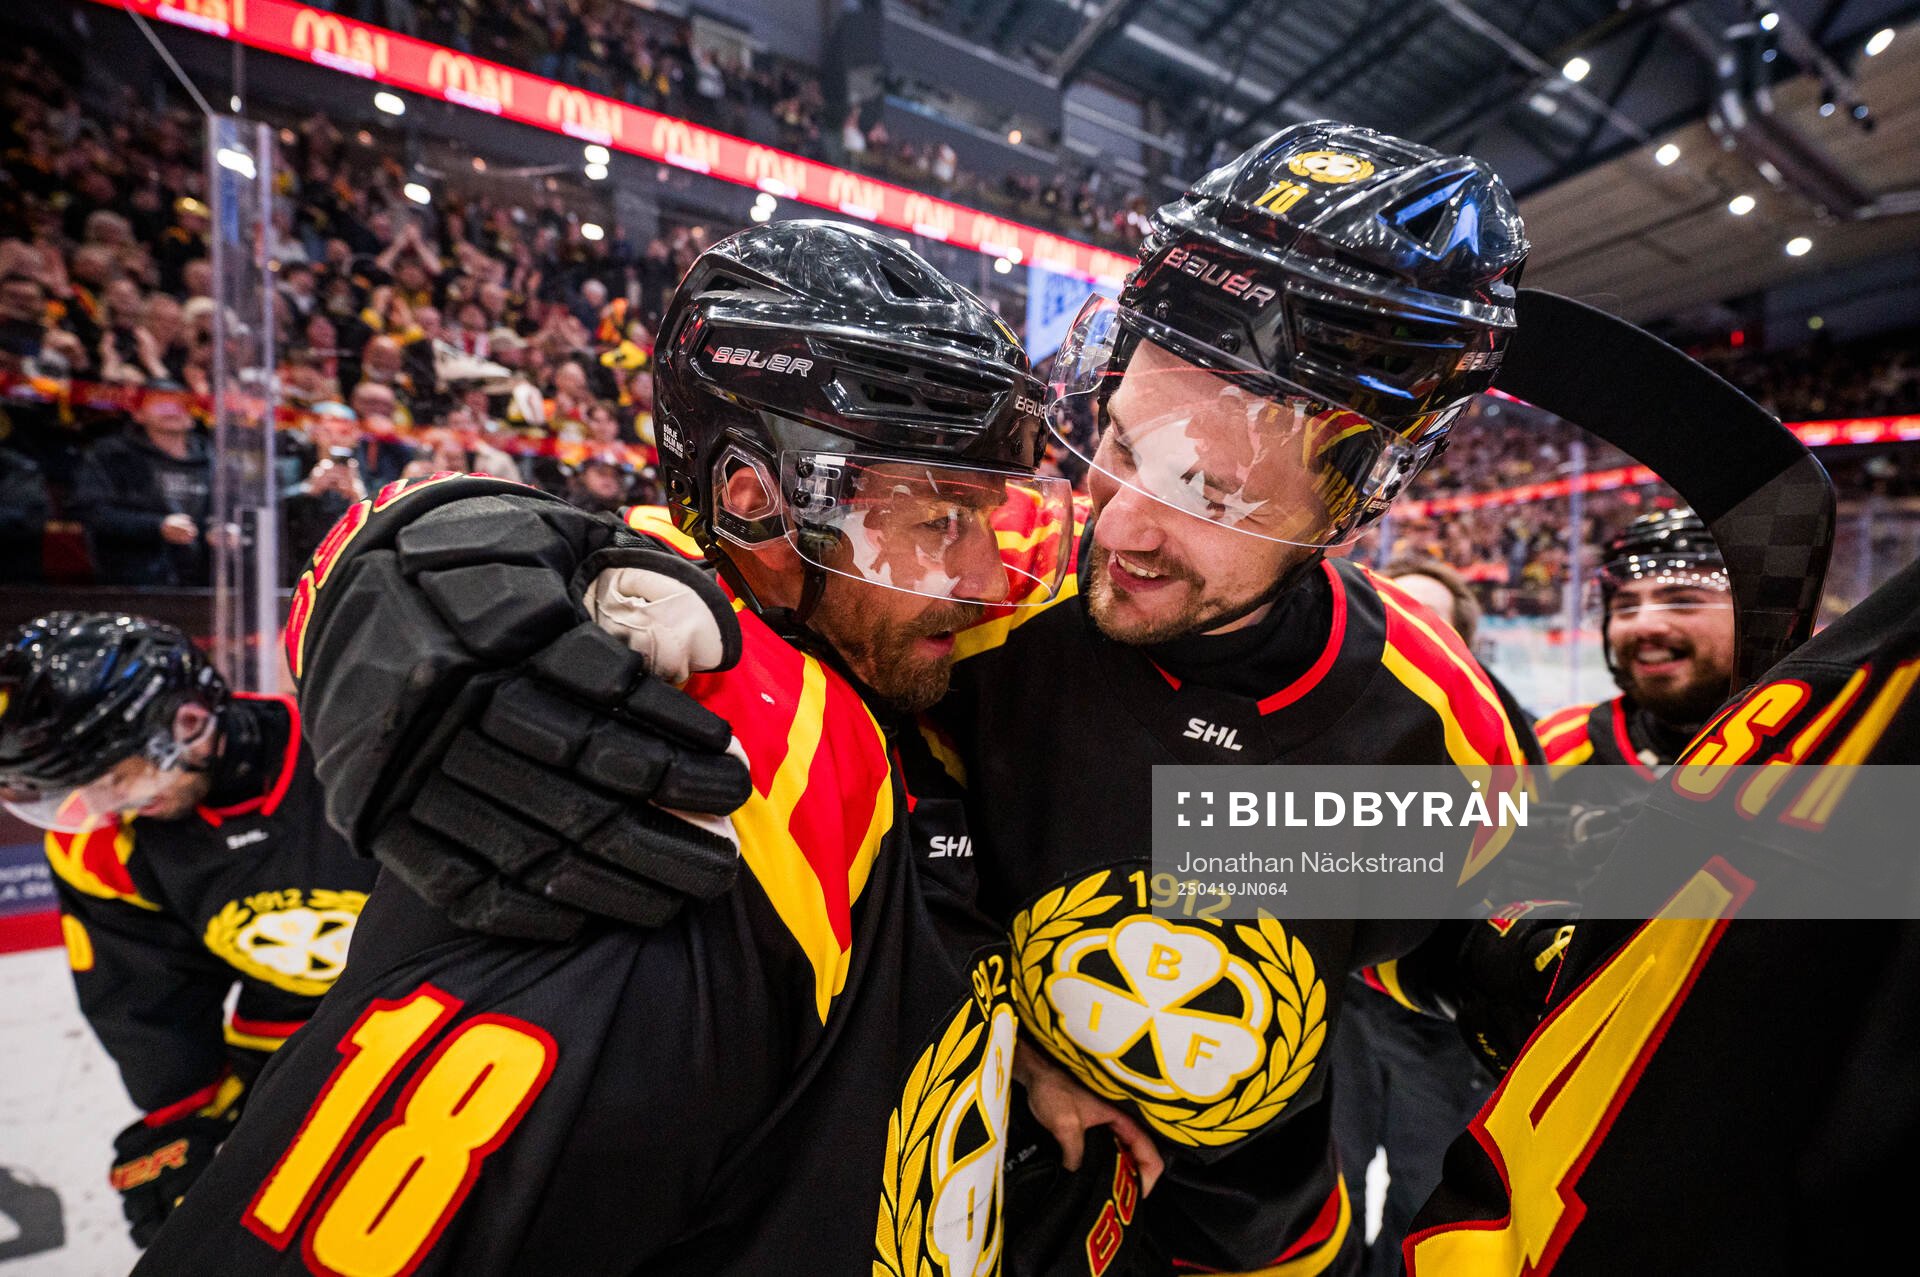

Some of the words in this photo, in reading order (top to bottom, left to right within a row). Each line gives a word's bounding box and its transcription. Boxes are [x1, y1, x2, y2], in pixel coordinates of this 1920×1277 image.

[1163, 247, 1277, 308] BAUER
[712, 346, 814, 377] BAUER
[1182, 717, 1243, 752] SHL
[1128, 870, 1232, 928] 1912
[1146, 943, 1183, 982] B
[1087, 1001, 1104, 1033] I
[1183, 1032, 1222, 1070] F
[241, 982, 559, 1277] 18
